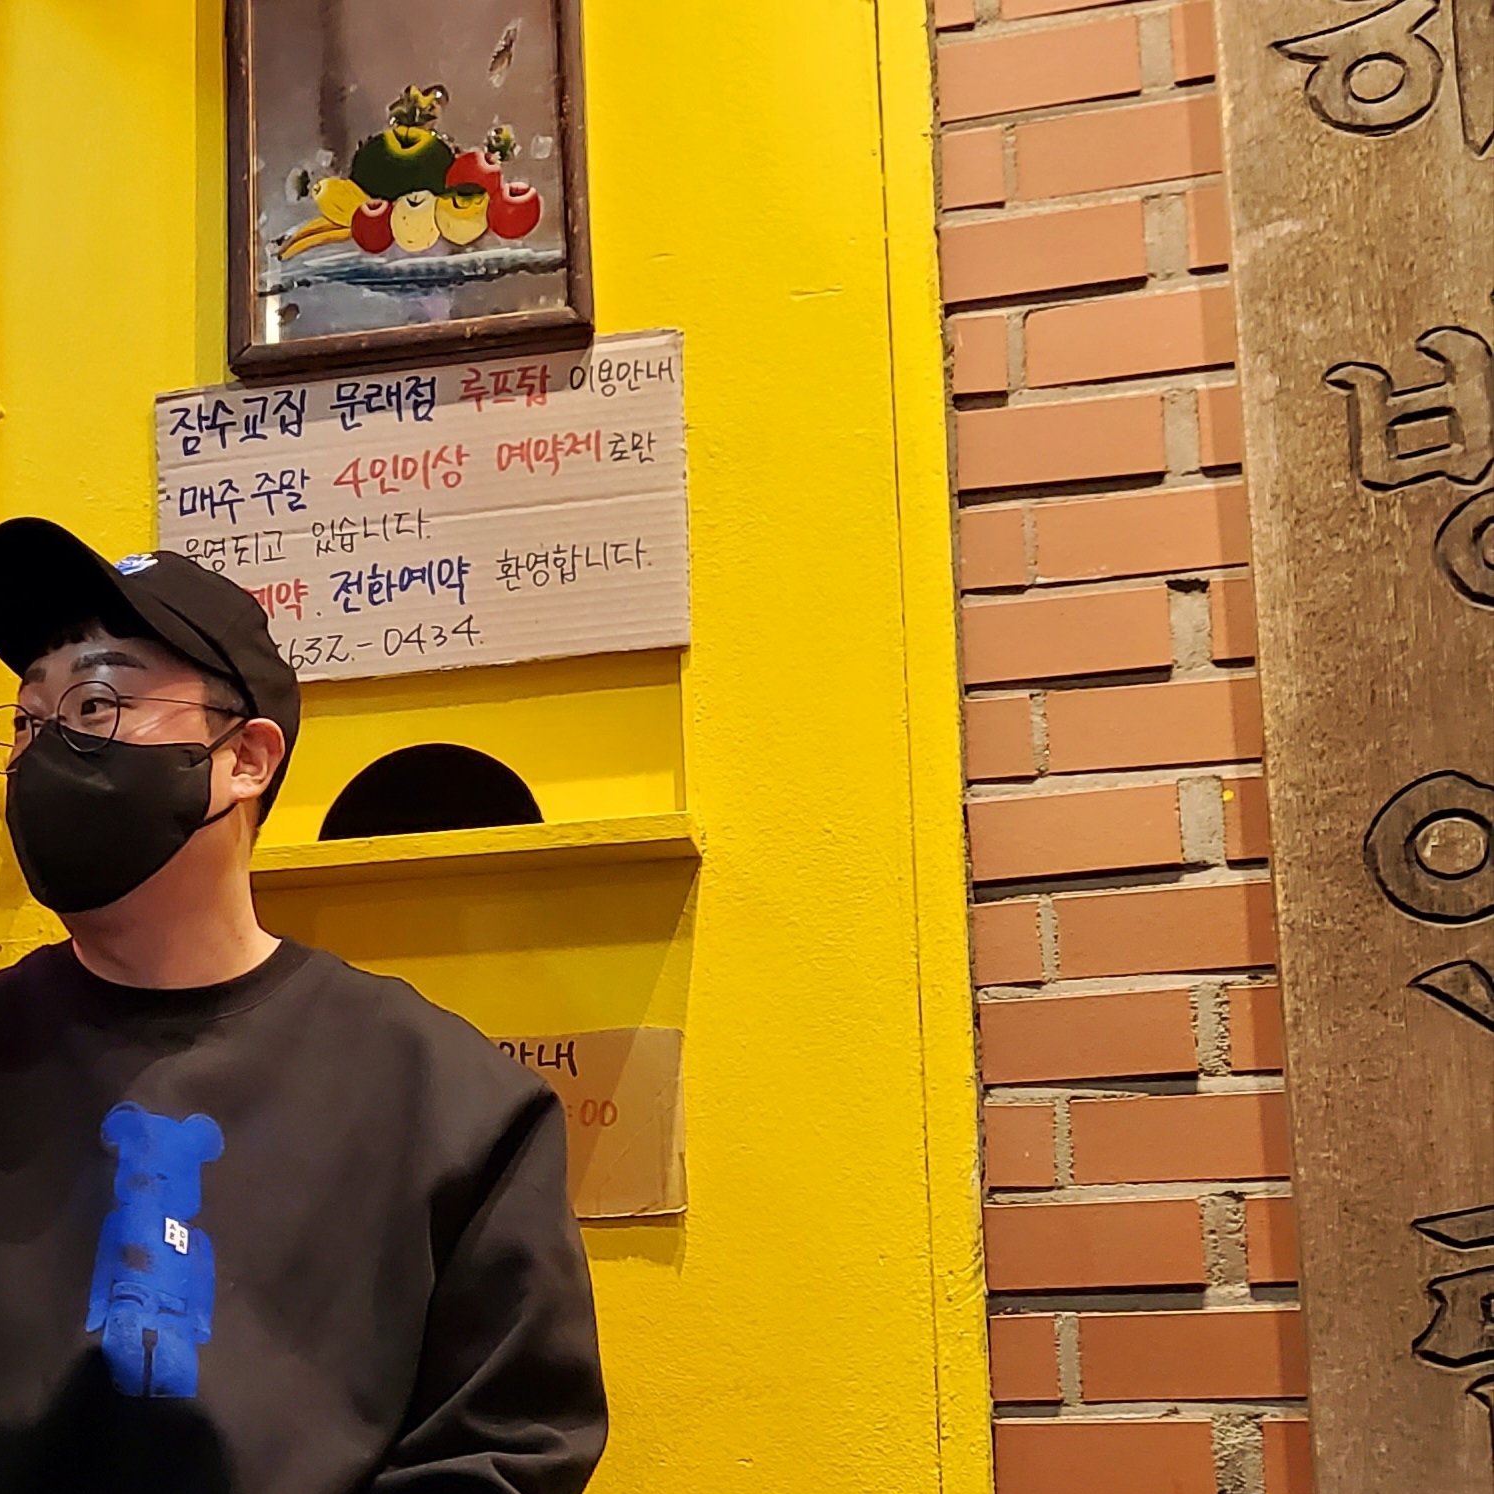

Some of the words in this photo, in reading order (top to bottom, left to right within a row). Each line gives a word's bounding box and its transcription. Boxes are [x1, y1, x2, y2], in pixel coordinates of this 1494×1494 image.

[169, 388, 307, 457] 잠수교집
[329, 375, 437, 432] 문래점
[459, 363, 552, 413] 루프탑
[569, 356, 676, 398] 이용안내
[179, 478, 246, 525] 매주
[250, 467, 311, 517] 주말
[332, 443, 471, 499] 4인이상
[311, 507, 432, 558] 있습니다.
[495, 537, 653, 592] 환영합니다.
